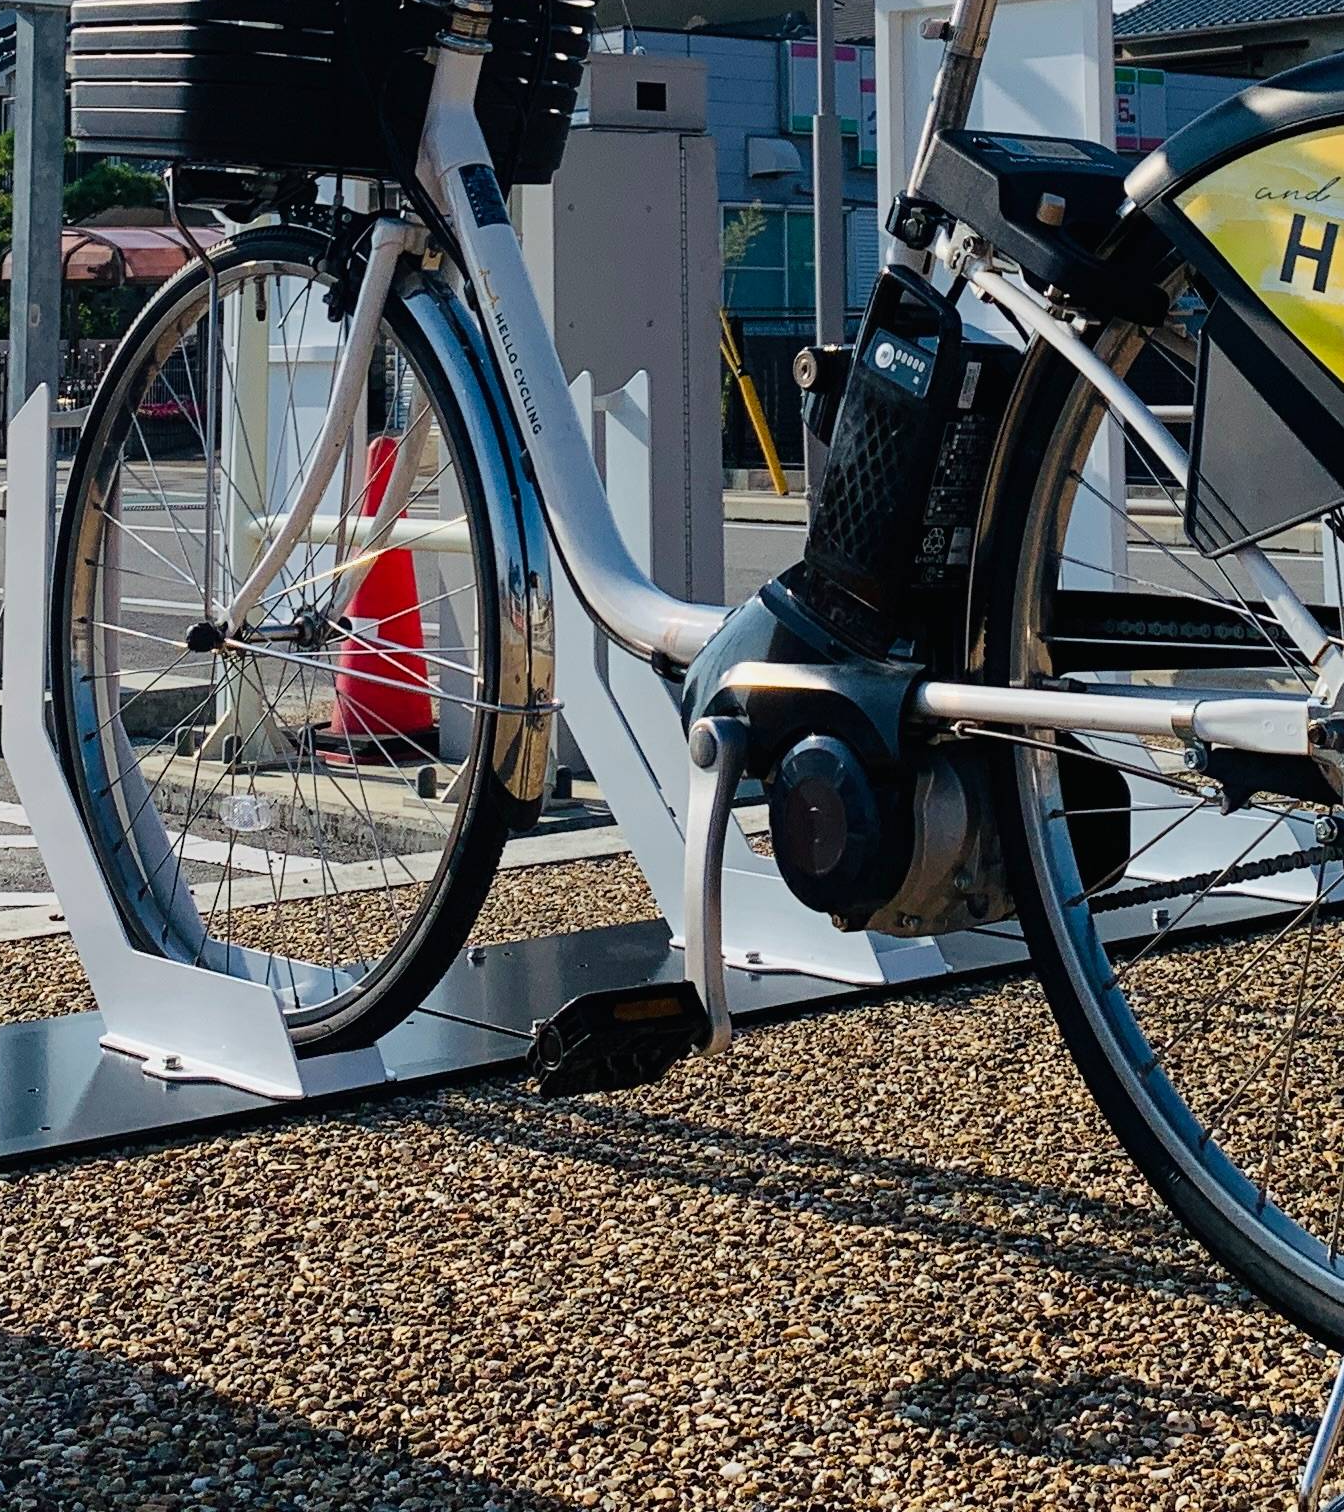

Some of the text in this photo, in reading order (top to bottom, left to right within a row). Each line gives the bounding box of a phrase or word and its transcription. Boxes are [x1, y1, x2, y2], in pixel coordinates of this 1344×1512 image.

[1255, 176, 1342, 203] and
[494, 312, 542, 435] HELLO CYCLING
